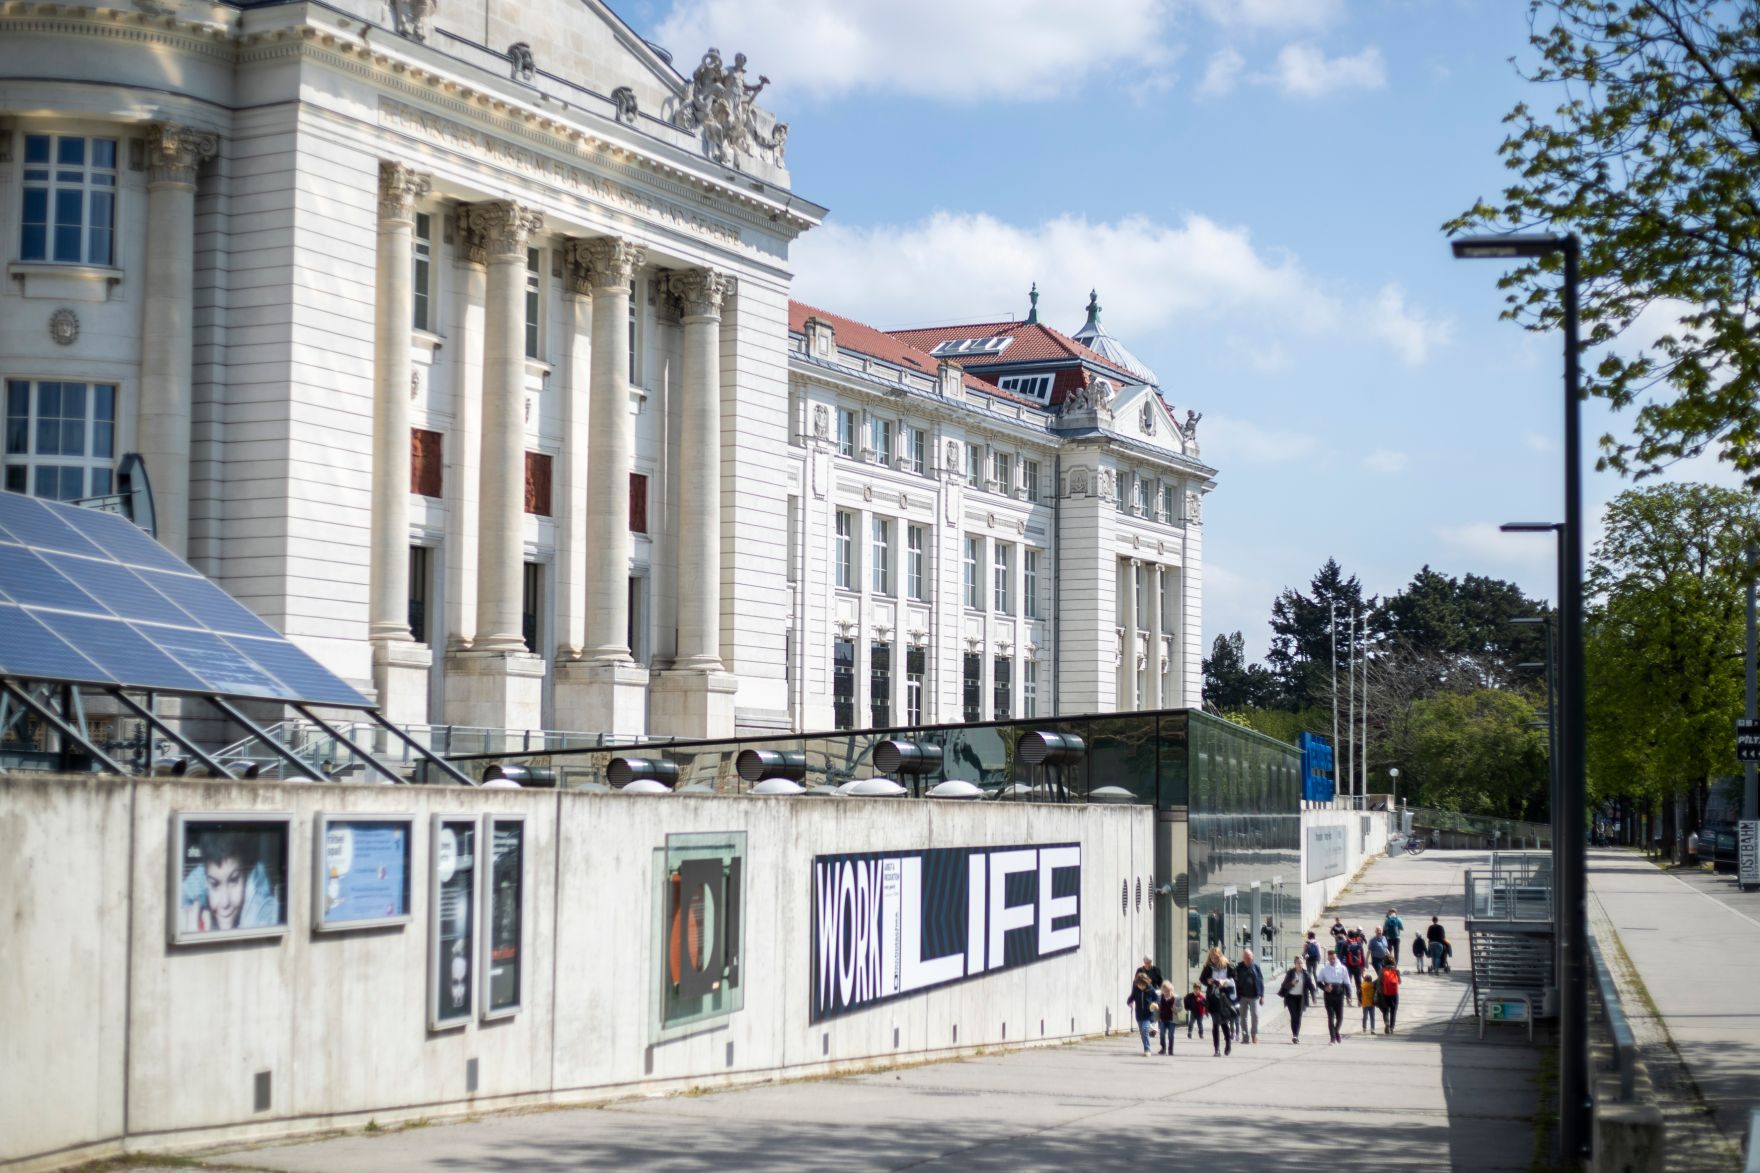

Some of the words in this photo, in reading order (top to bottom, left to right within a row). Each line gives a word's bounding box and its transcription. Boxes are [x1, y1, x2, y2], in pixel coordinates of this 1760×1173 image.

[485, 138, 546, 177] MUSEUM
[658, 201, 684, 226] UND
[1741, 822, 1754, 873] OSTBAHN
[817, 859, 883, 1011] WORK
[901, 846, 1080, 992] LIFE
